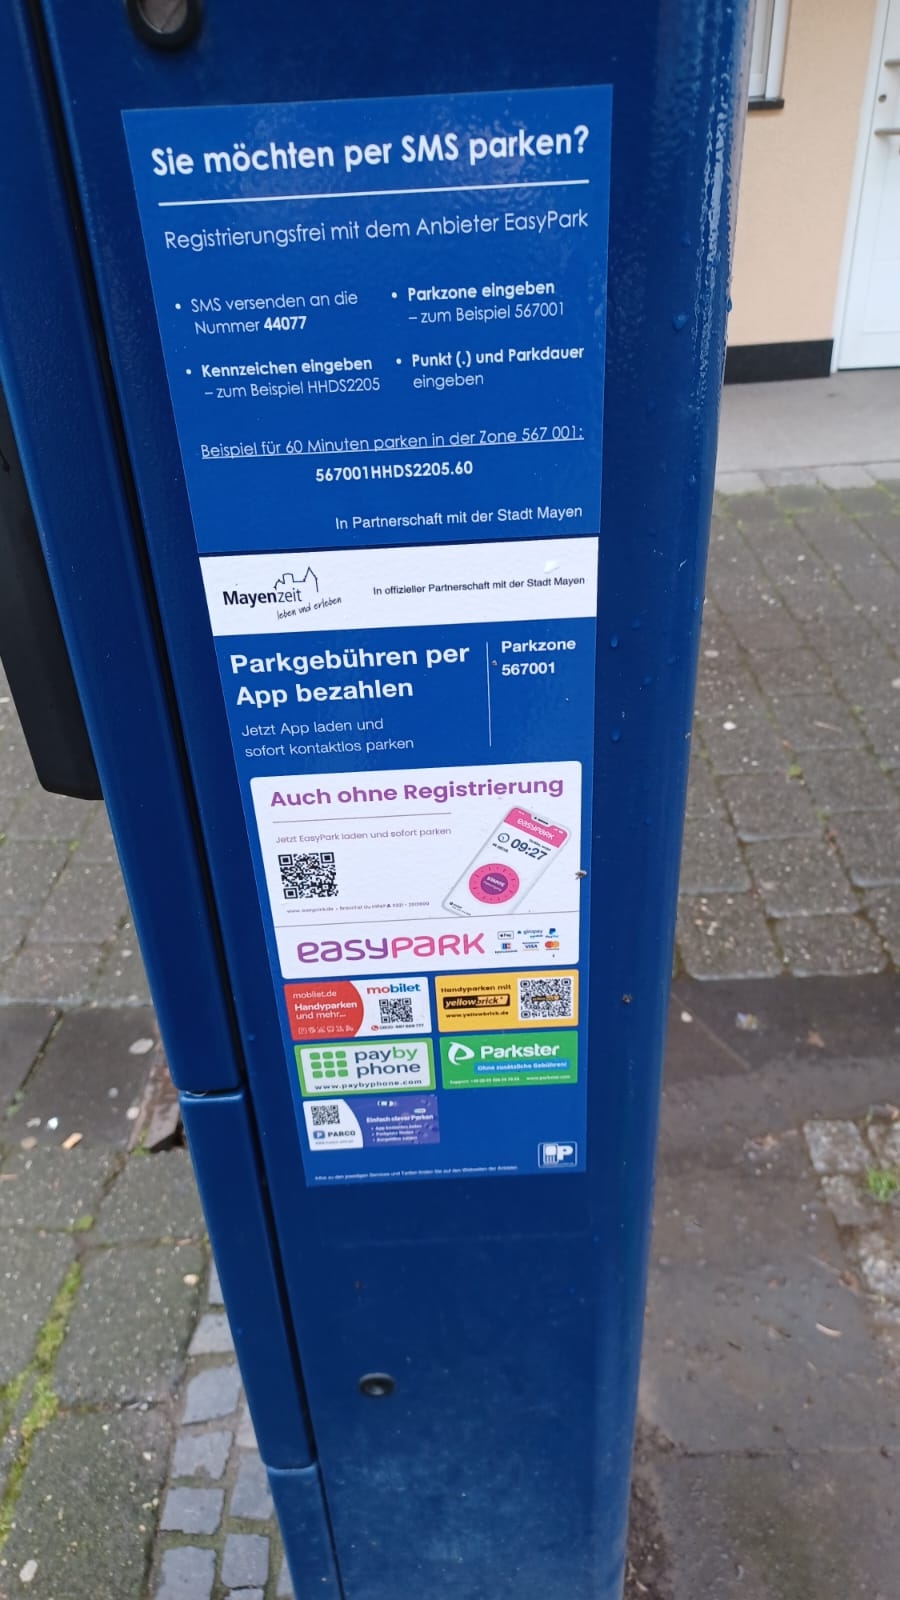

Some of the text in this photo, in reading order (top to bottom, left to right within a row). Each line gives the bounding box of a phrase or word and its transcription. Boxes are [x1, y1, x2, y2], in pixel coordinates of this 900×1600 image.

[151, 125, 589, 176] Sie möchten per SMS parken?
[165, 209, 588, 251] Registrierungsfrei mit dem Anbieter EasyPark
[408, 280, 554, 301] Parkzone eingeben
[190, 291, 358, 313] SMS versenden an die
[421, 302, 564, 325] zum Beispiel 567001
[195, 316, 307, 335] Nummer 44077
[412, 352, 451, 368] Punkt
[476, 350, 503, 364] und
[508, 344, 584, 362] Parkdauer
[201, 357, 372, 378] Kennzeichen eingeben
[217, 377, 380, 399] zum Beispiel HHDS2205
[413, 373, 484, 391] eingeben
[201, 425, 584, 459] Beispiel für 60 Minuten parken in der Zone 567 001:
[315, 461, 473, 482] 567001HHDS2205.60
[336, 505, 582, 529] In Partnerschaft mit der Stadt Mayen
[385, 584, 426, 594] offizieller
[428, 582, 489, 592] Partnerschaft
[493, 581, 506, 590] mit
[509, 580, 524, 589] der
[527, 578, 551, 588] Stadt
[554, 577, 585, 588] Mayen
[223, 588, 302, 609] Mayenzeit
[277, 596, 342, 621] leben und erleben
[501, 638, 575, 653] Parkzone
[230, 646, 469, 674] Parkgebühren per
[502, 663, 555, 676] 567001
[236, 680, 413, 708] App bezahlen
[242, 718, 383, 736] Jetzt App laden und
[245, 739, 414, 757] sofort kontaktlos parken
[271, 777, 563, 807] Auch ohne Registrierung
[276, 827, 451, 844] Jetzt EasyPark laden und sofort parken
[510, 838, 548, 861] 09:27
[293, 991, 336, 999] mobilet.de
[367, 983, 421, 994] mobilet
[441, 985, 495, 993] Handyparken
[294, 1002, 357, 1011] Handyparken
[445, 995, 498, 1008] yellowbrick
[354, 1047, 417, 1063] payby
[481, 1044, 560, 1059] Parkster
[356, 1062, 420, 1078] phone
[315, 1080, 422, 1090] www.paybyphone.com
